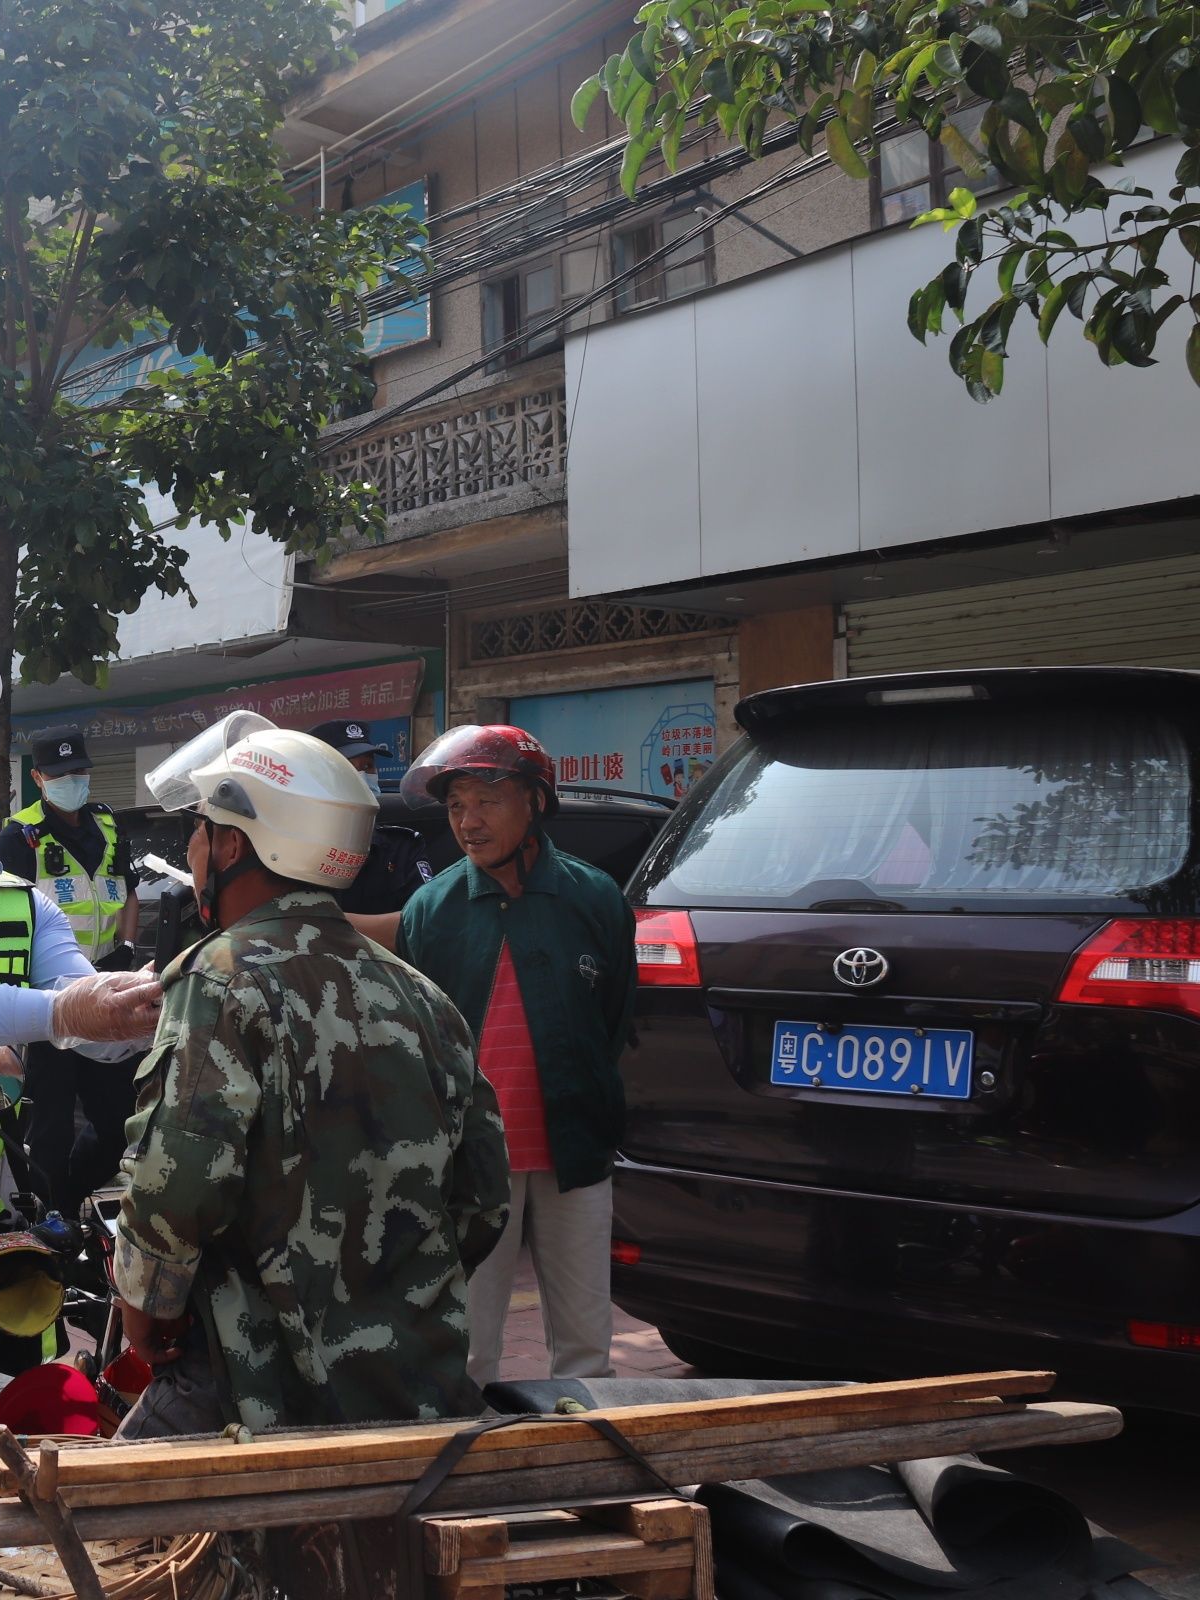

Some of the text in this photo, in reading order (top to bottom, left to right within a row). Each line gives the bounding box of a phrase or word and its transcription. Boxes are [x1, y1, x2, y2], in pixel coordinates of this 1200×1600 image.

[360, 679, 417, 706] 新品上
[661, 725, 713, 742] 垃圾不落地
